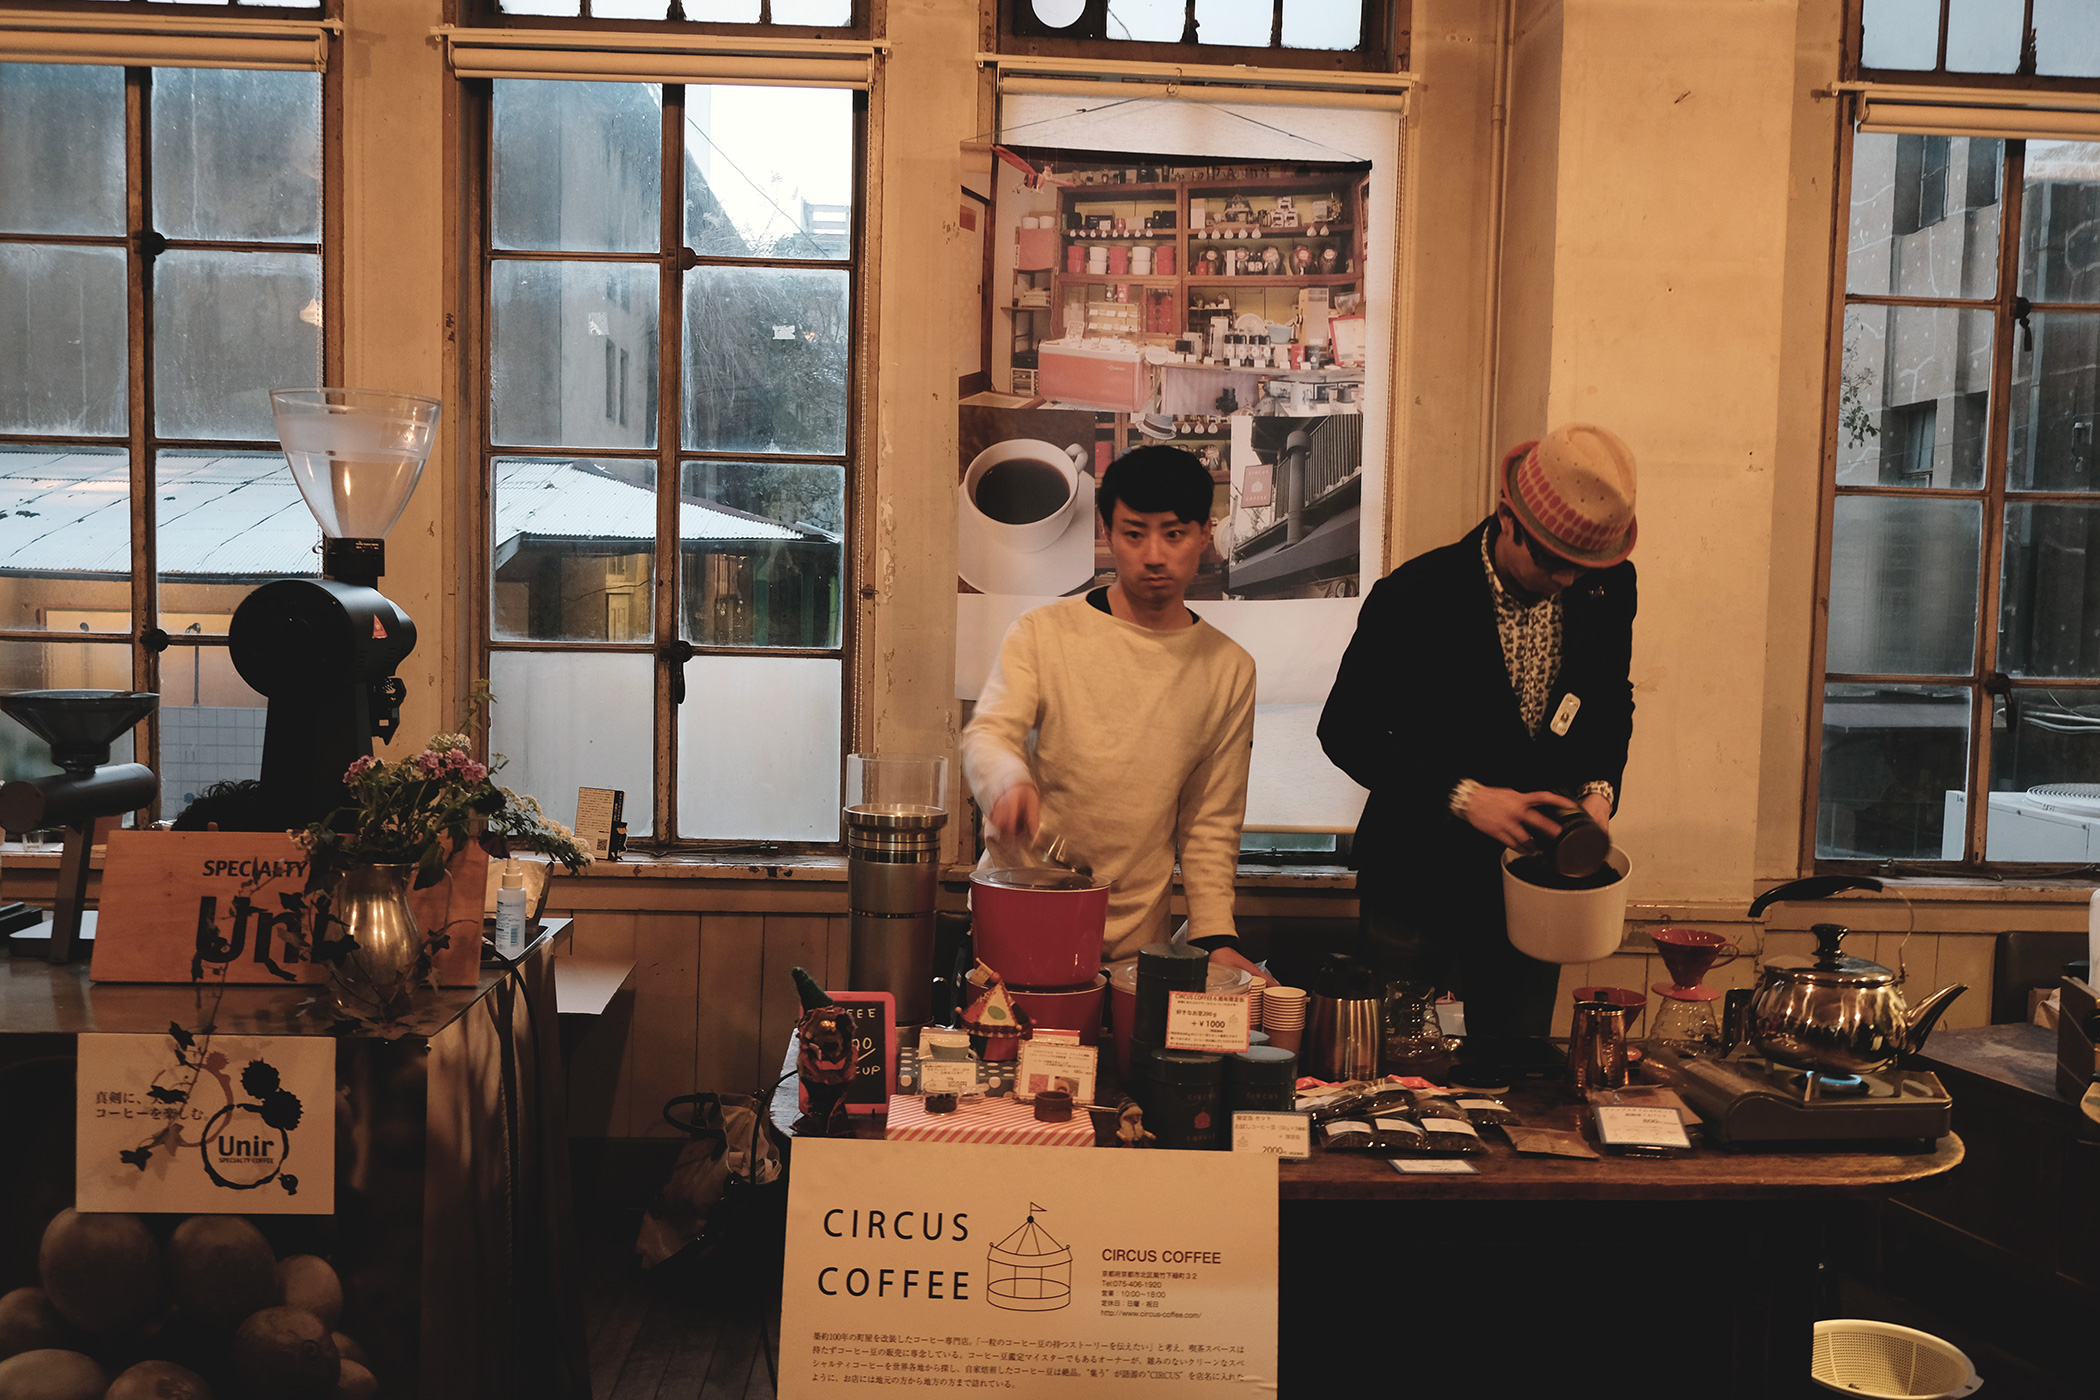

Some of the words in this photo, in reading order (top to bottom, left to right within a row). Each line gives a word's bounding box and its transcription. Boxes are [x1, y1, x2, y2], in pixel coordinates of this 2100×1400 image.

[196, 895, 330, 964] Uni
[851, 1036, 873, 1050] 00
[96, 1107, 209, 1122] コーヒーを楽しむ。
[218, 1135, 274, 1157] Unir
[218, 1157, 251, 1165] SPECIALTY
[252, 1157, 274, 1165] COFFEE
[822, 1208, 969, 1242] CIRCUS
[1101, 1248, 1158, 1263] CIRCUS
[1161, 1250, 1222, 1264] COFFEE
[817, 1266, 969, 1301] COFFEE
[1101, 1280, 1162, 1289] Tel:075-406-1920
[1100, 1309, 1202, 1319] http://www.circus-coffee.com/
